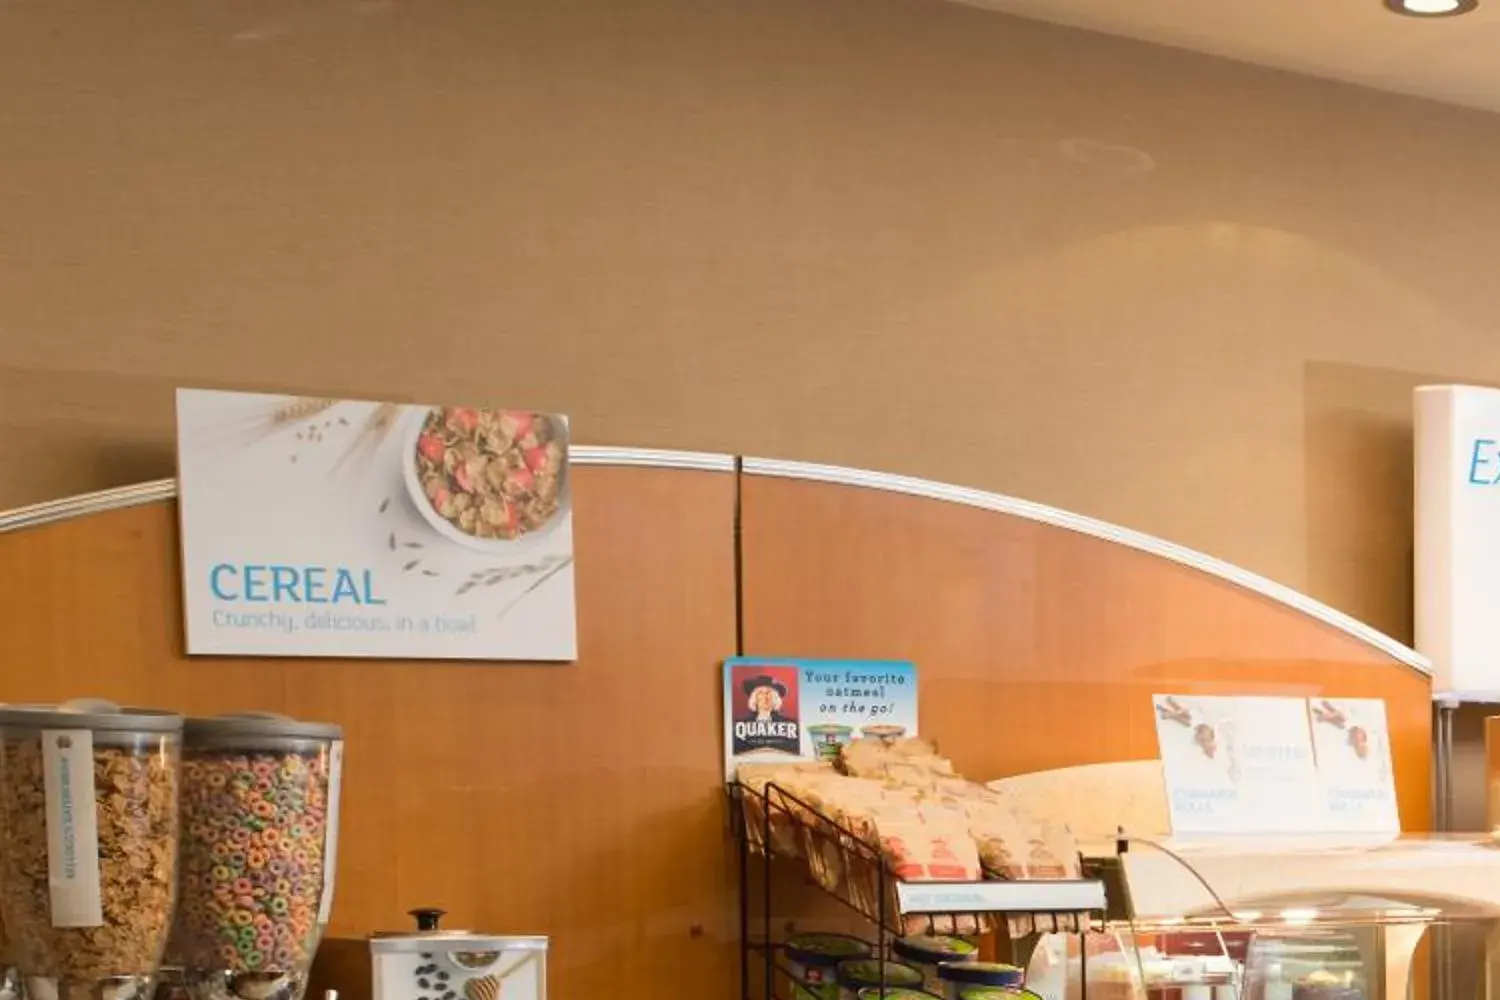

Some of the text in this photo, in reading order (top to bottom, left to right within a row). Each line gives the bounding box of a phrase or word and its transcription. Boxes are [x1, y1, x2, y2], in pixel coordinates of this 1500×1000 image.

[210, 562, 388, 605] CEREAL
[805, 670, 838, 684] Your
[825, 685, 885, 699] oatmeal
[819, 703, 837, 713] on
[843, 701, 866, 713] the
[735, 721, 799, 740] QUAKER
